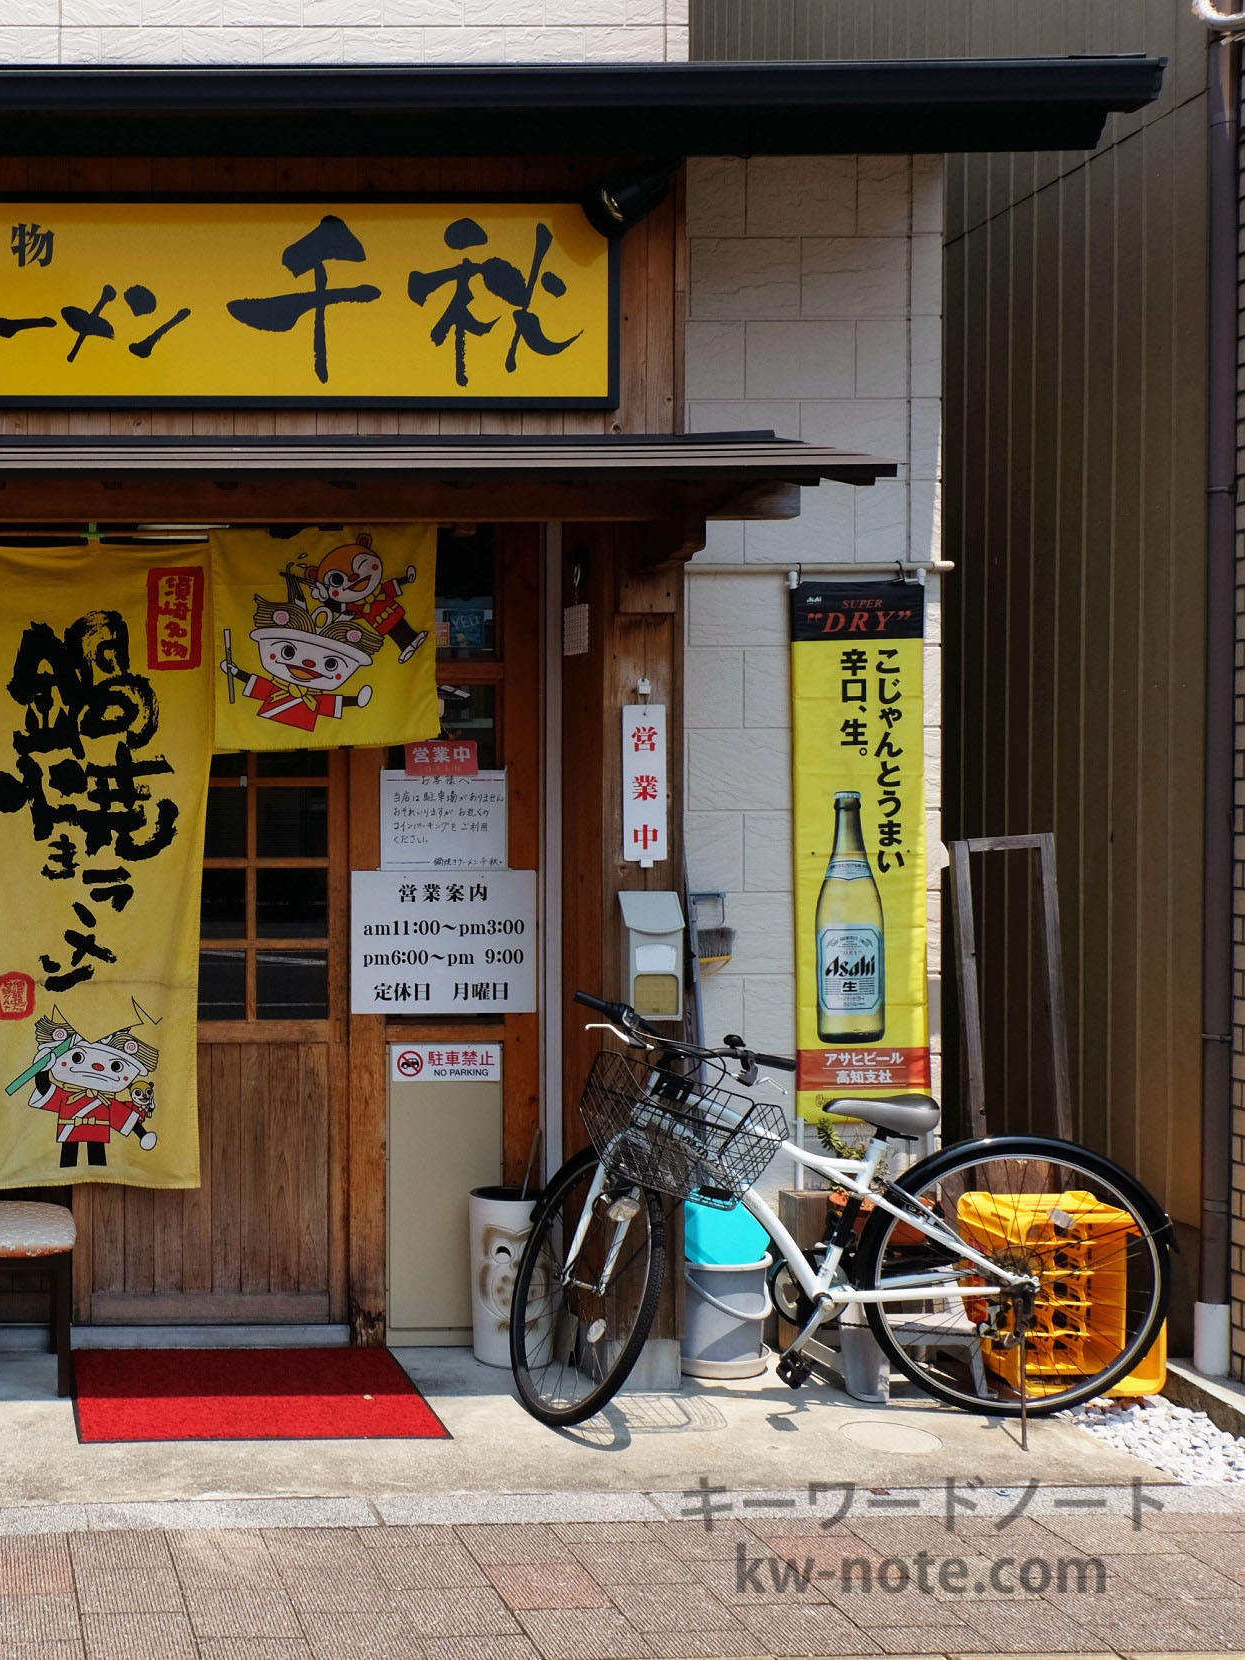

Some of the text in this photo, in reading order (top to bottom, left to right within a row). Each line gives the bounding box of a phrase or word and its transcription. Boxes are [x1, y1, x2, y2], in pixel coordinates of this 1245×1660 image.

[226, 214, 584, 387] 千秋
[842, 599, 884, 609] SUPER
[157, 575, 192, 659] 須崎名物
[840, 649, 868, 756] 辛口、生。
[412, 745, 471, 763] 営業中
[874, 648, 905, 873] こじゃんとうまい
[631, 726, 659, 851] 営業中
[398, 883, 488, 903] 営業案内
[485, 948, 524, 965] 9:00
[825, 955, 875, 977] Asahi
[374, 982, 508, 1001] 定休日 月曜日
[842, 981, 858, 993] 生
[427, 1050, 495, 1066] 駐車禁止
[824, 1052, 904, 1066] アサヒビール
[434, 1068, 489, 1077] NO PARKING
[836, 1070, 893, 1084] 高知支社
